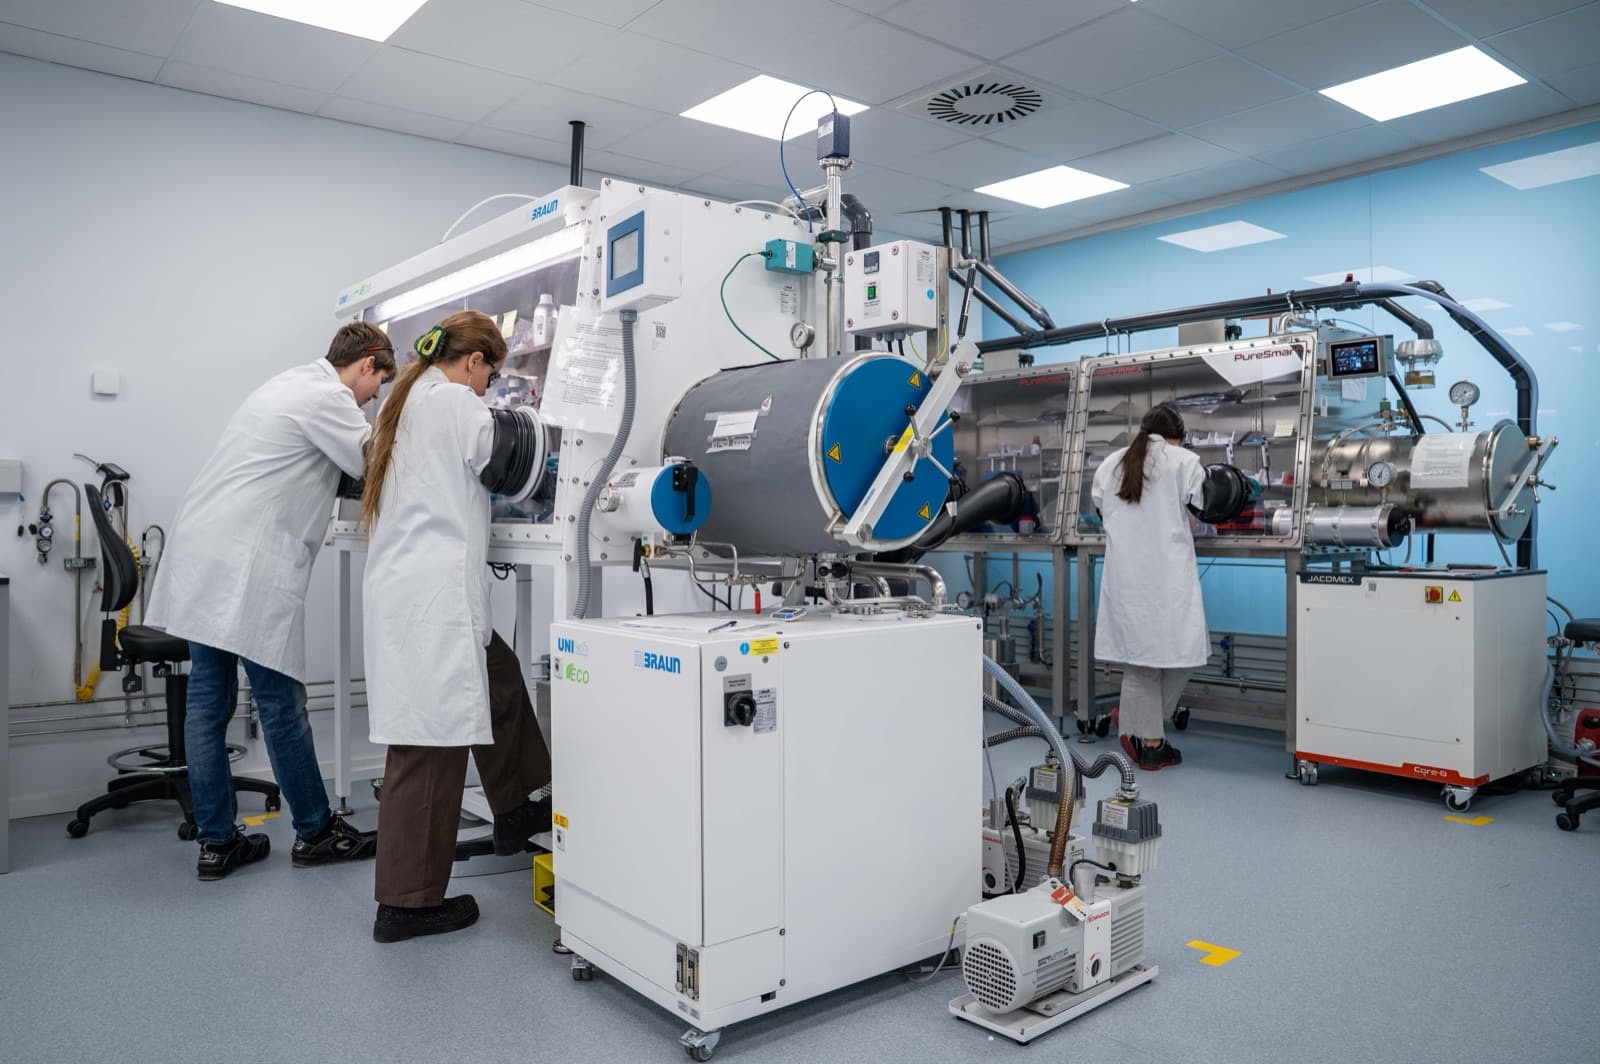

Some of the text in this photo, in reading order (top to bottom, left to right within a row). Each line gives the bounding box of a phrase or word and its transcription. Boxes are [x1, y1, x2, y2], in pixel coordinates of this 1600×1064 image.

[531, 199, 558, 220] BRAUN
[1307, 575, 1354, 584] JACOMEX
[644, 652, 681, 674] BRAUN
